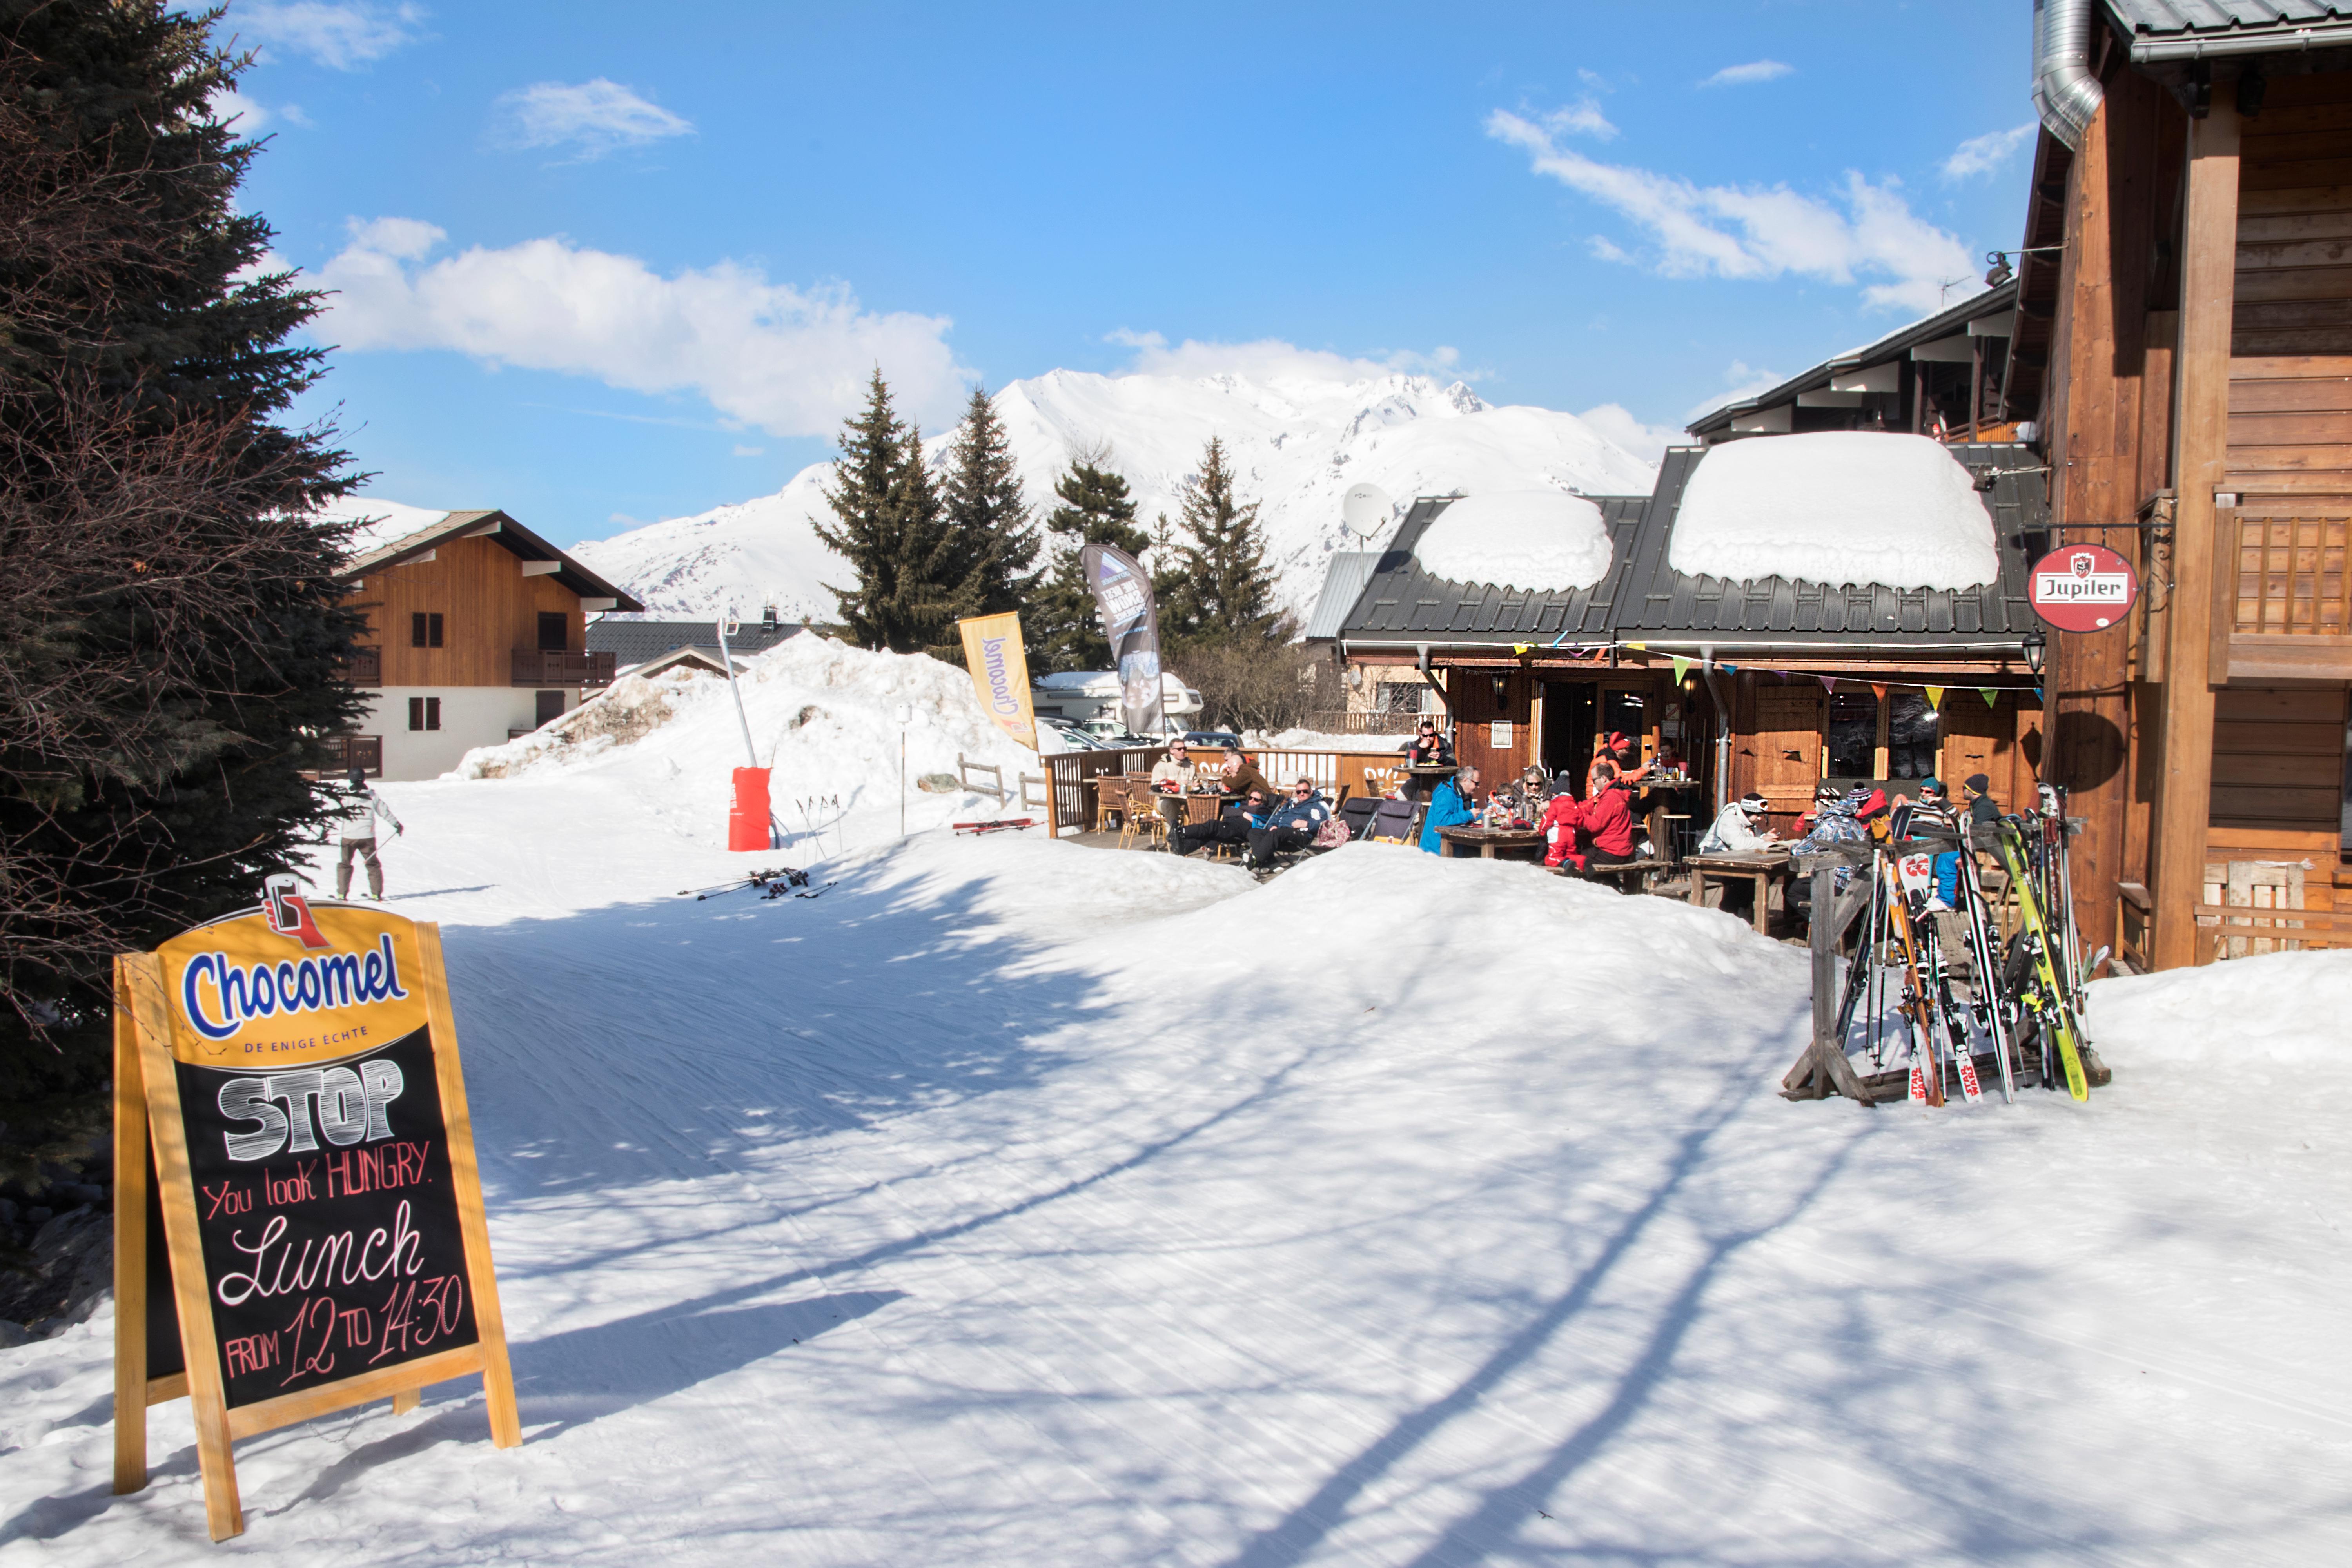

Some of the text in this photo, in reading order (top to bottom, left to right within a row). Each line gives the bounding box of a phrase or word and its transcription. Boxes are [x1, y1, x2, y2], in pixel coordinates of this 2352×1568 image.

[2043, 579, 2121, 599] Jupiler
[183, 933, 407, 1039] Chocomel
[245, 1043, 263, 1053] DE
[271, 1038, 316, 1052] ENIGE
[1961, 1065, 1972, 1096] STAR
[1965, 1066, 1979, 1096] WARS
[218, 1060, 403, 1161] STOP
[265, 1159, 317, 1206] look
[218, 1200, 425, 1305] Lunch
[225, 1274, 463, 1387] FROM 12 TO 14:30
